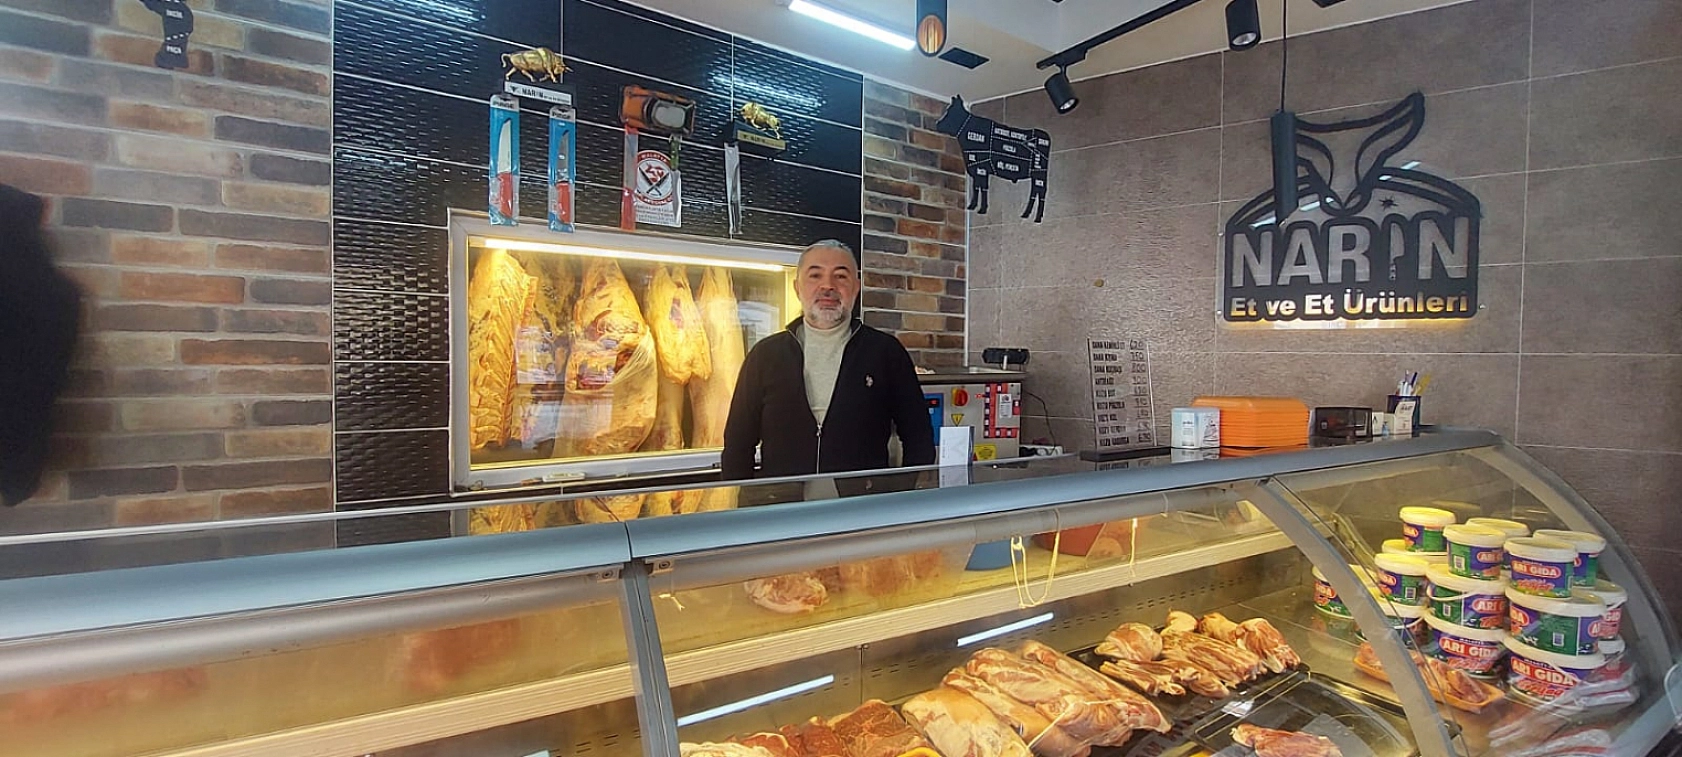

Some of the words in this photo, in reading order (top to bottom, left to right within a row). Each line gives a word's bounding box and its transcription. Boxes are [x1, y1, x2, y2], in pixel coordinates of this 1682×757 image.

[1231, 297, 1257, 316] Et
[1266, 301, 1297, 316] ve
[1304, 294, 1335, 315] Et
[1344, 289, 1468, 314] Ürünleri
[1530, 566, 1557, 577] GIDA
[1443, 640, 1465, 654] ARI
[1512, 659, 1531, 676] ARI
[1534, 668, 1574, 686] GIDA
